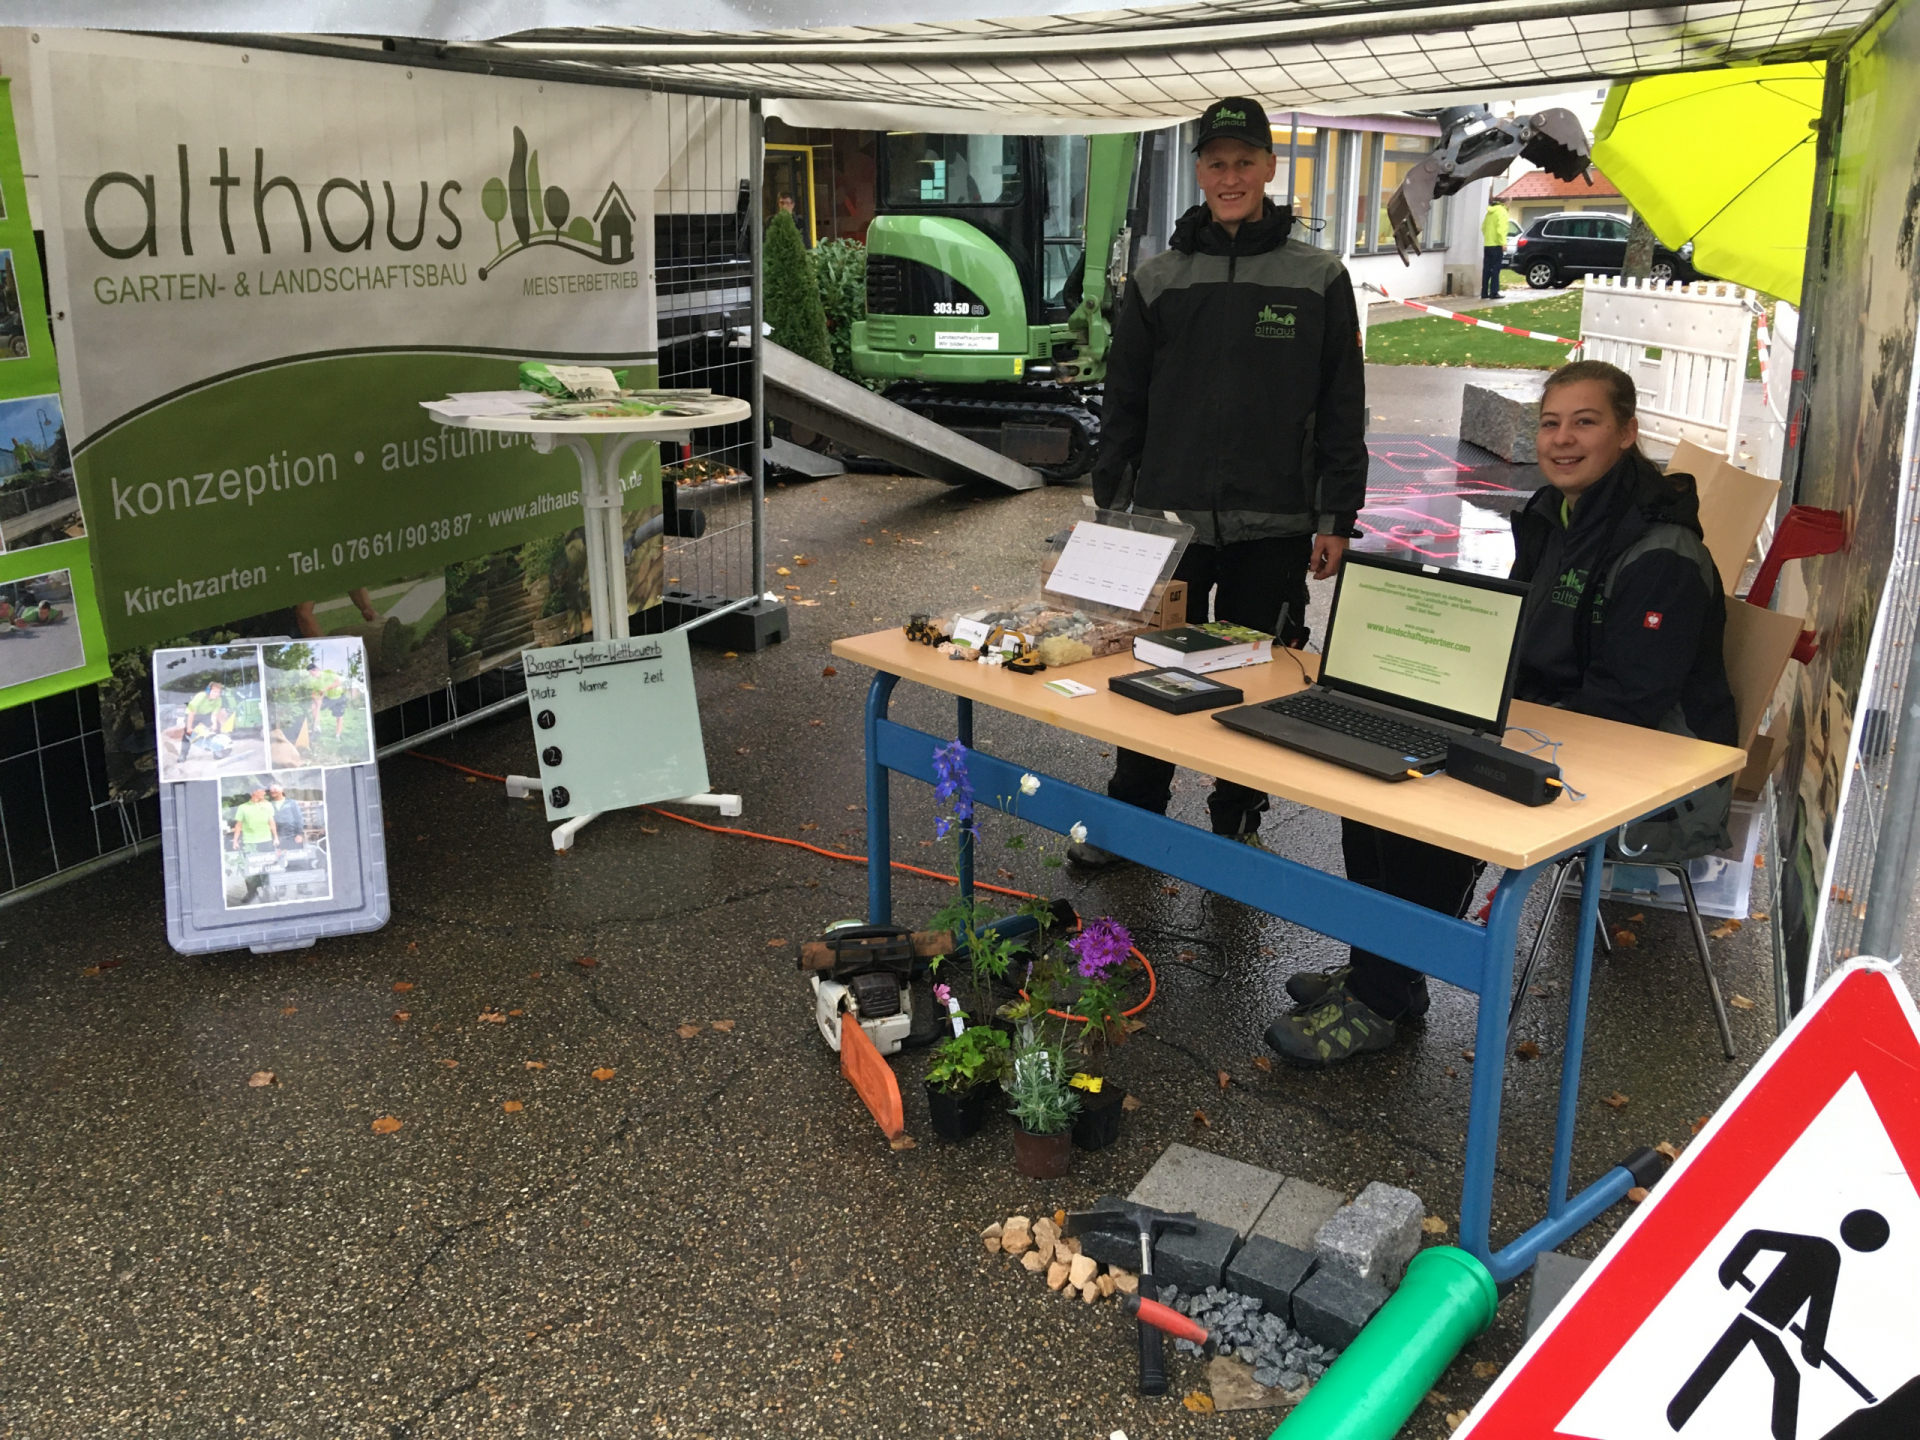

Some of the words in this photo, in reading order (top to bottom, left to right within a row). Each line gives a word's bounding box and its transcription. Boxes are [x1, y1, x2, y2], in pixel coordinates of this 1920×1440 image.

[1211, 119, 1247, 130] althaus
[85, 144, 463, 260] althaus
[94, 273, 226, 305] GARTEN-
[233, 271, 250, 297] &
[258, 263, 467, 295] LANDSCHAFTSBAU
[522, 271, 639, 296] MEISTERBETRIEB
[933, 302, 970, 315] 303.5D
[1254, 324, 1296, 336] althaus
[112, 450, 337, 521] konzeption
[124, 566, 267, 616] Kirchzarten
[288, 549, 326, 576] Tel.
[1169, 590, 1182, 602] CAT
[1366, 622, 1471, 653] www.landschaftsgaertner.com
[530, 686, 557, 700] Platz
[578, 680, 608, 692] Name
[643, 669, 665, 684] Zeit
[541, 712, 551, 726] 1
[548, 749, 558, 762] 2
[1473, 763, 1507, 782] ANKER
